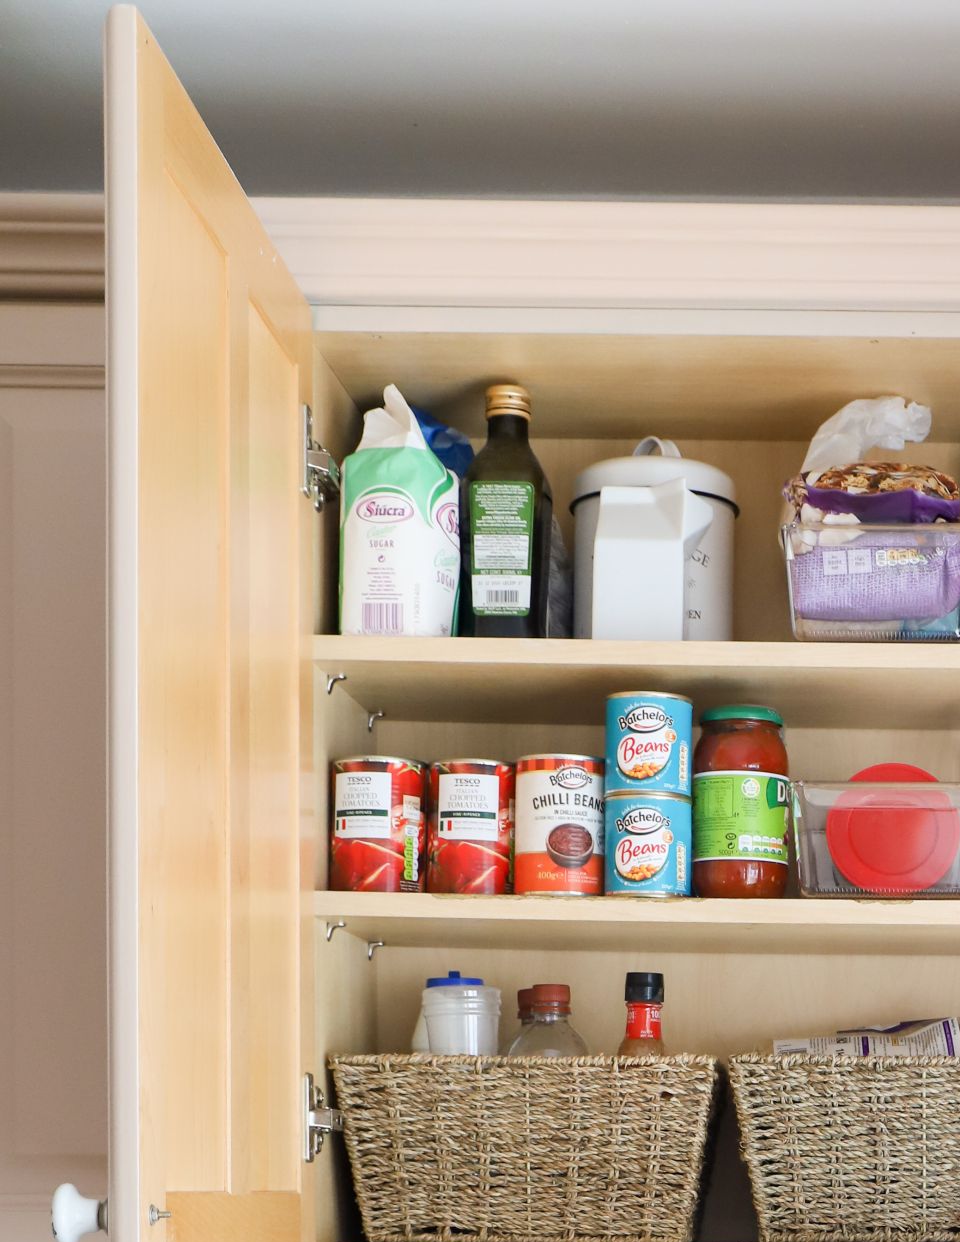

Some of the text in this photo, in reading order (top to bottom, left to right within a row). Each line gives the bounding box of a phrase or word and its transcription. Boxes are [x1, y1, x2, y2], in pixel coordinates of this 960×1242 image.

[364, 501, 406, 518] Siúcra
[369, 539, 395, 549] SUGAR
[620, 737, 669, 763] Beans
[532, 793, 605, 814] CHILLI BEANS
[618, 839, 667, 866] Beans
